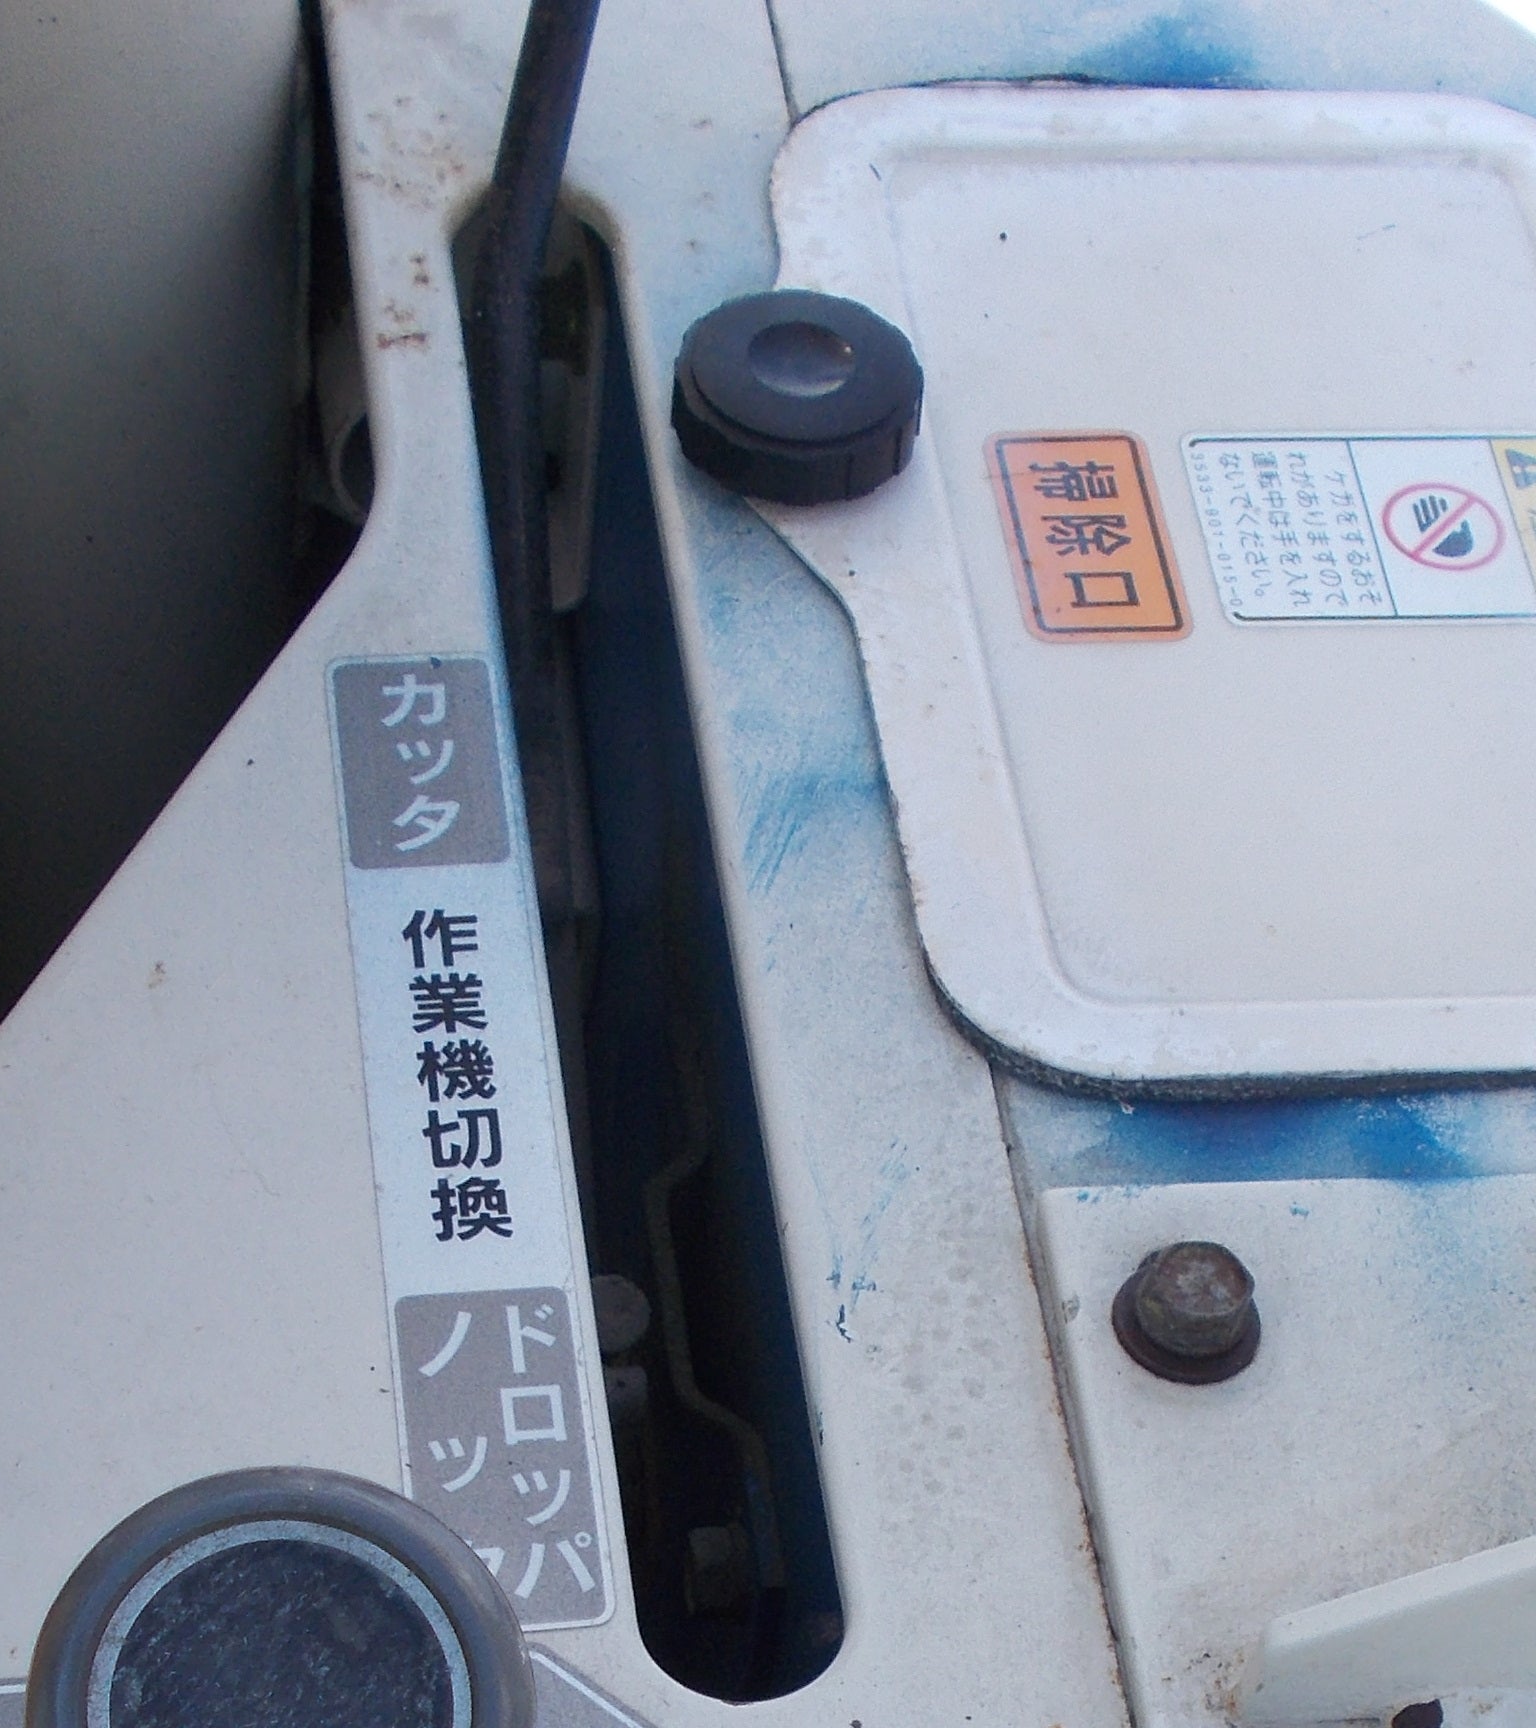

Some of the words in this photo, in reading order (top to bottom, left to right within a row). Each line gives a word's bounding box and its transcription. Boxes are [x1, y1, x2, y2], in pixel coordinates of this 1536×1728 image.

[1026, 458, 1141, 610] 掃除口
[1219, 452, 1274, 598] ないでください。
[1251, 451, 1314, 608] 運転中は手を入れ
[1287, 450, 1350, 608] れがありますので
[1324, 470, 1383, 606] ケガをするおそ
[380, 672, 462, 854] カッタ
[401, 908, 514, 1243] 作業機切換
[499, 1303, 597, 1600] ドロッパ
